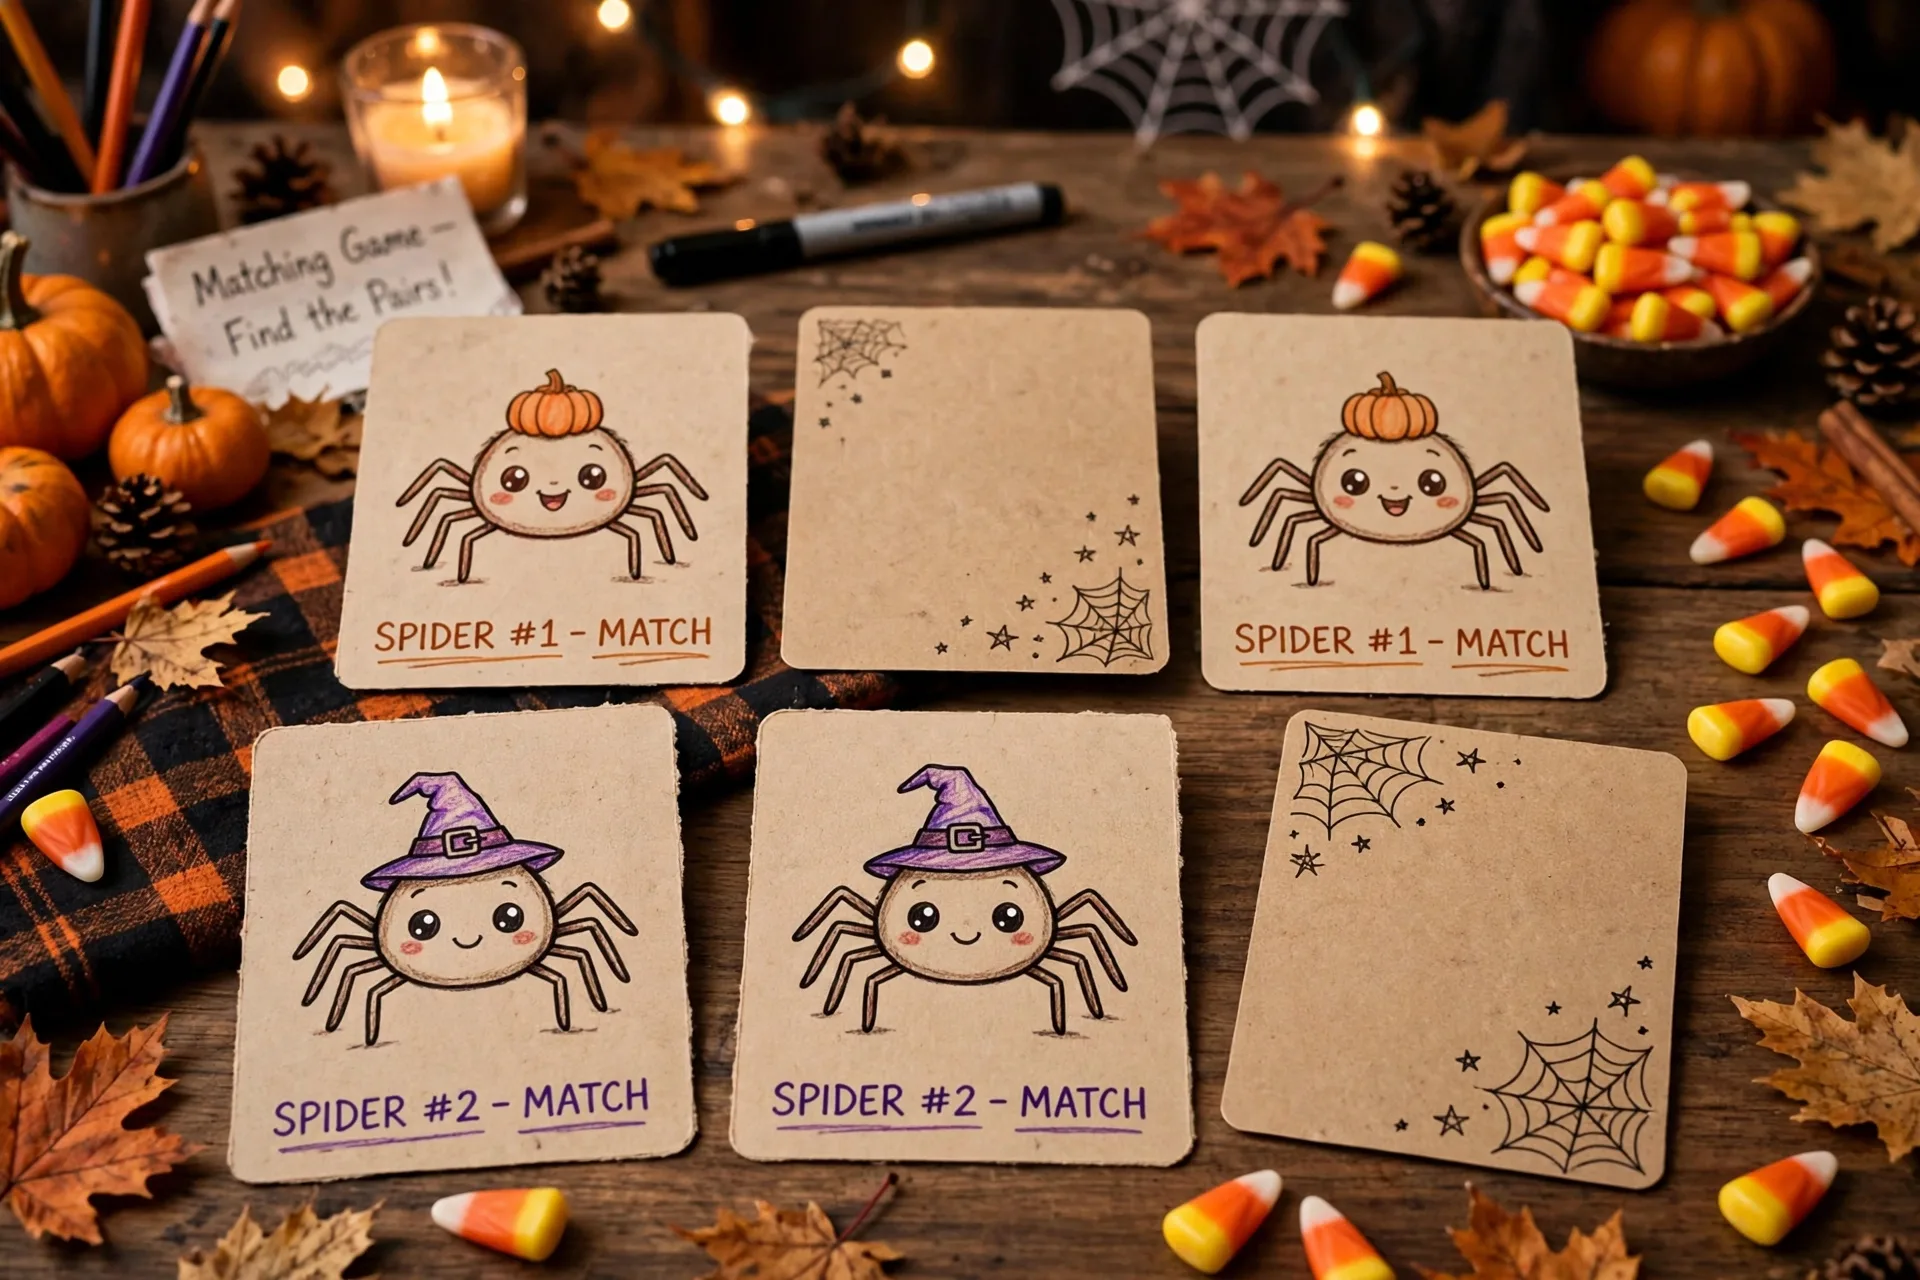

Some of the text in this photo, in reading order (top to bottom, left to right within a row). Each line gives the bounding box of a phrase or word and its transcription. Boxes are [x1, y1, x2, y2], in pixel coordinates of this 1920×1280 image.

[192, 251, 335, 307] Matching
[339, 224, 425, 265] Game
[223, 259, 454, 356] Find the Pairs!
[374, 620, 495, 652] SPIDER
[509, 618, 559, 647] #1
[598, 616, 712, 647] MATCH
[1235, 622, 1355, 655] SPIDER
[1367, 626, 1418, 655] #1
[1456, 627, 1569, 659] MATCH
[273, 1095, 407, 1136] SPIDER
[423, 1089, 480, 1123] #2
[523, 1077, 650, 1119] MATCH
[771, 1081, 905, 1117] SPIDER
[921, 1084, 978, 1117] #2
[1020, 1084, 1147, 1120] MATCH
